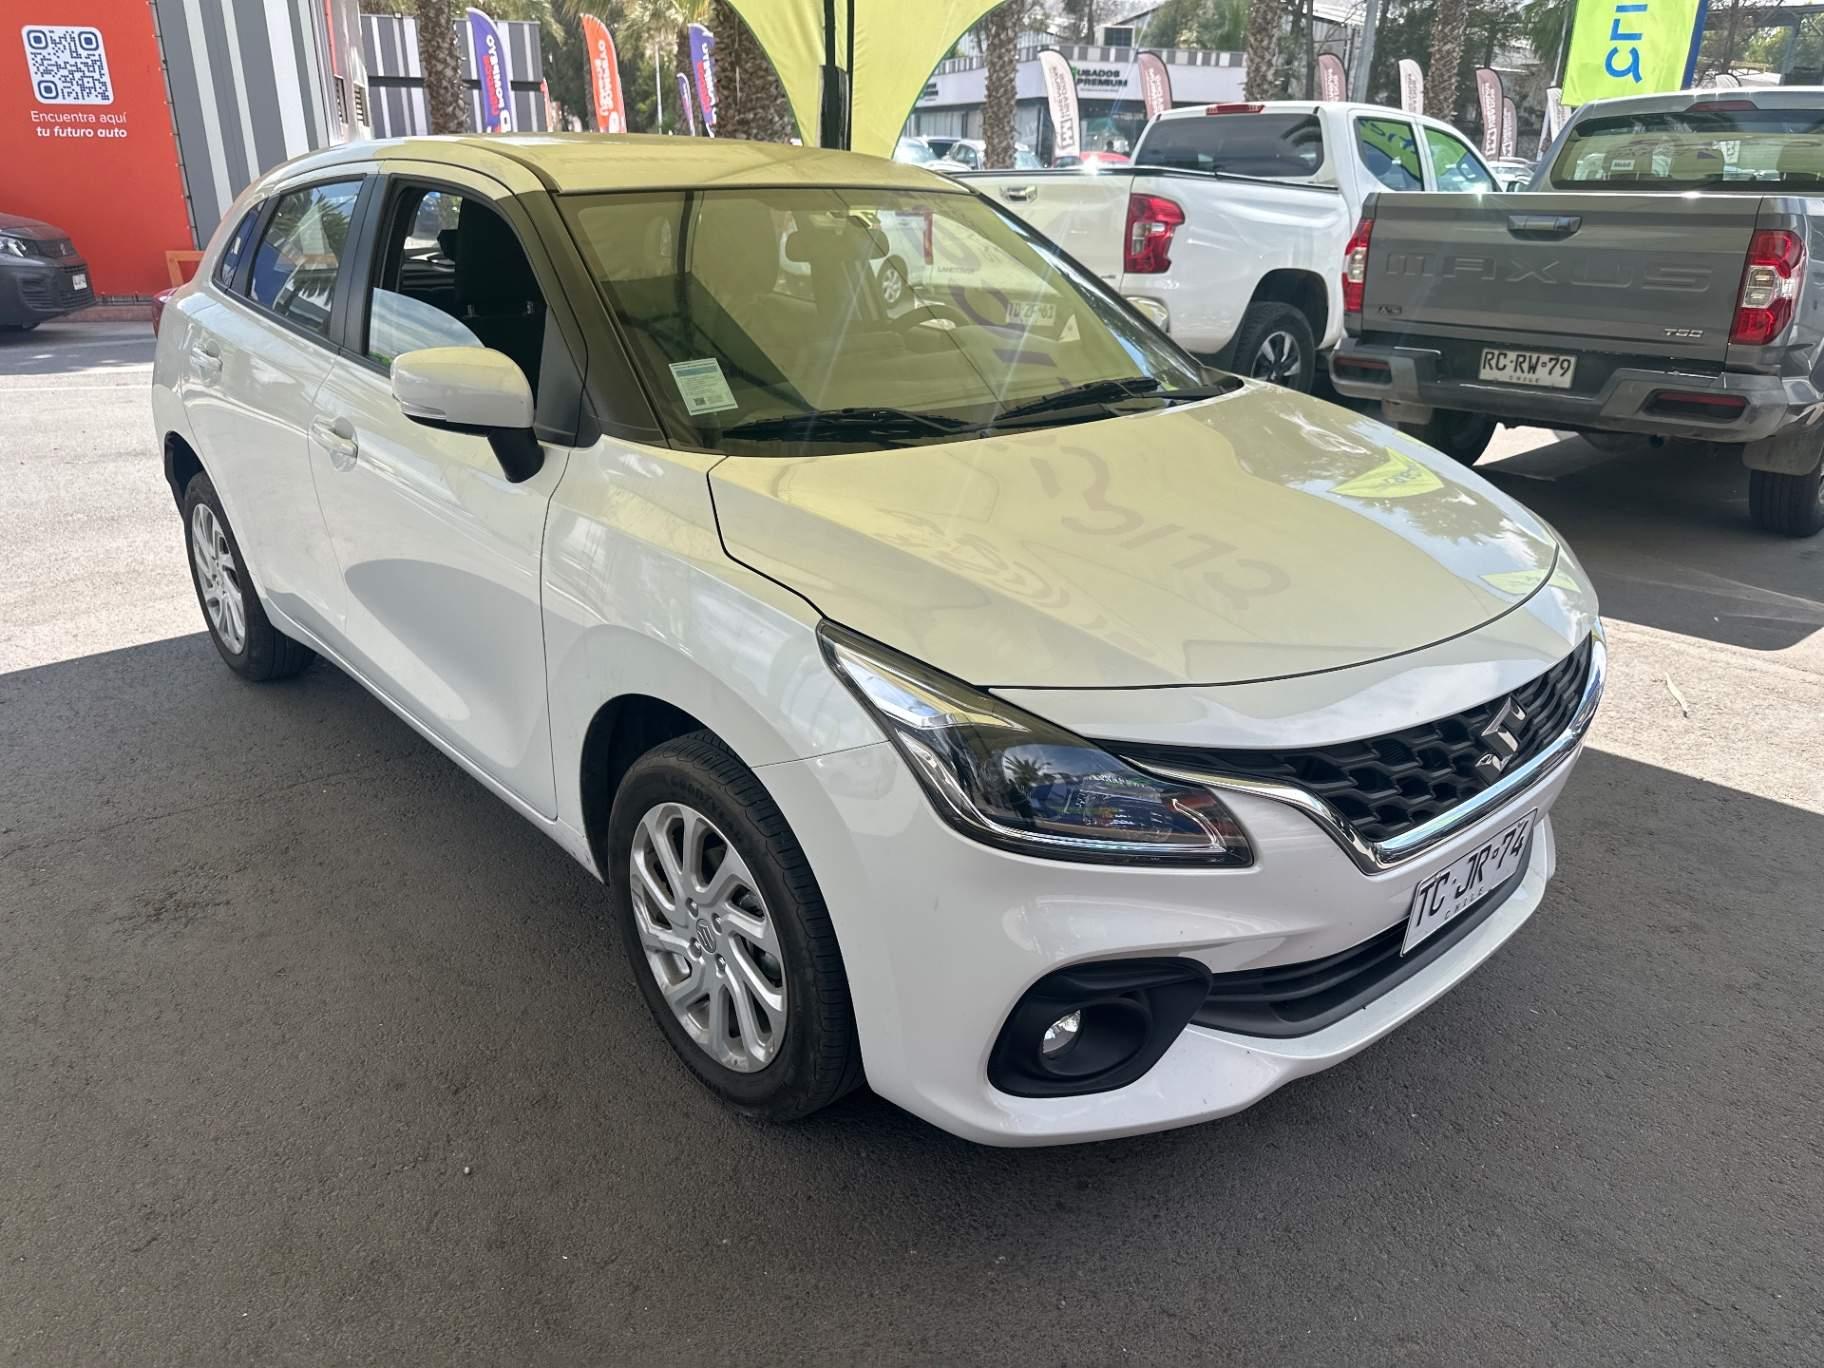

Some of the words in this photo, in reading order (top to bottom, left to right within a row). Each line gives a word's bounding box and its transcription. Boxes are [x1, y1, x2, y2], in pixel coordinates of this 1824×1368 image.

[31, 110, 96, 123] Encuentra
[99, 111, 127, 126] aquí
[36, 126, 50, 137] tu
[54, 126, 94, 137] futuro
[97, 127, 128, 138] auto
[1385, 252, 1714, 293] MAXUS
